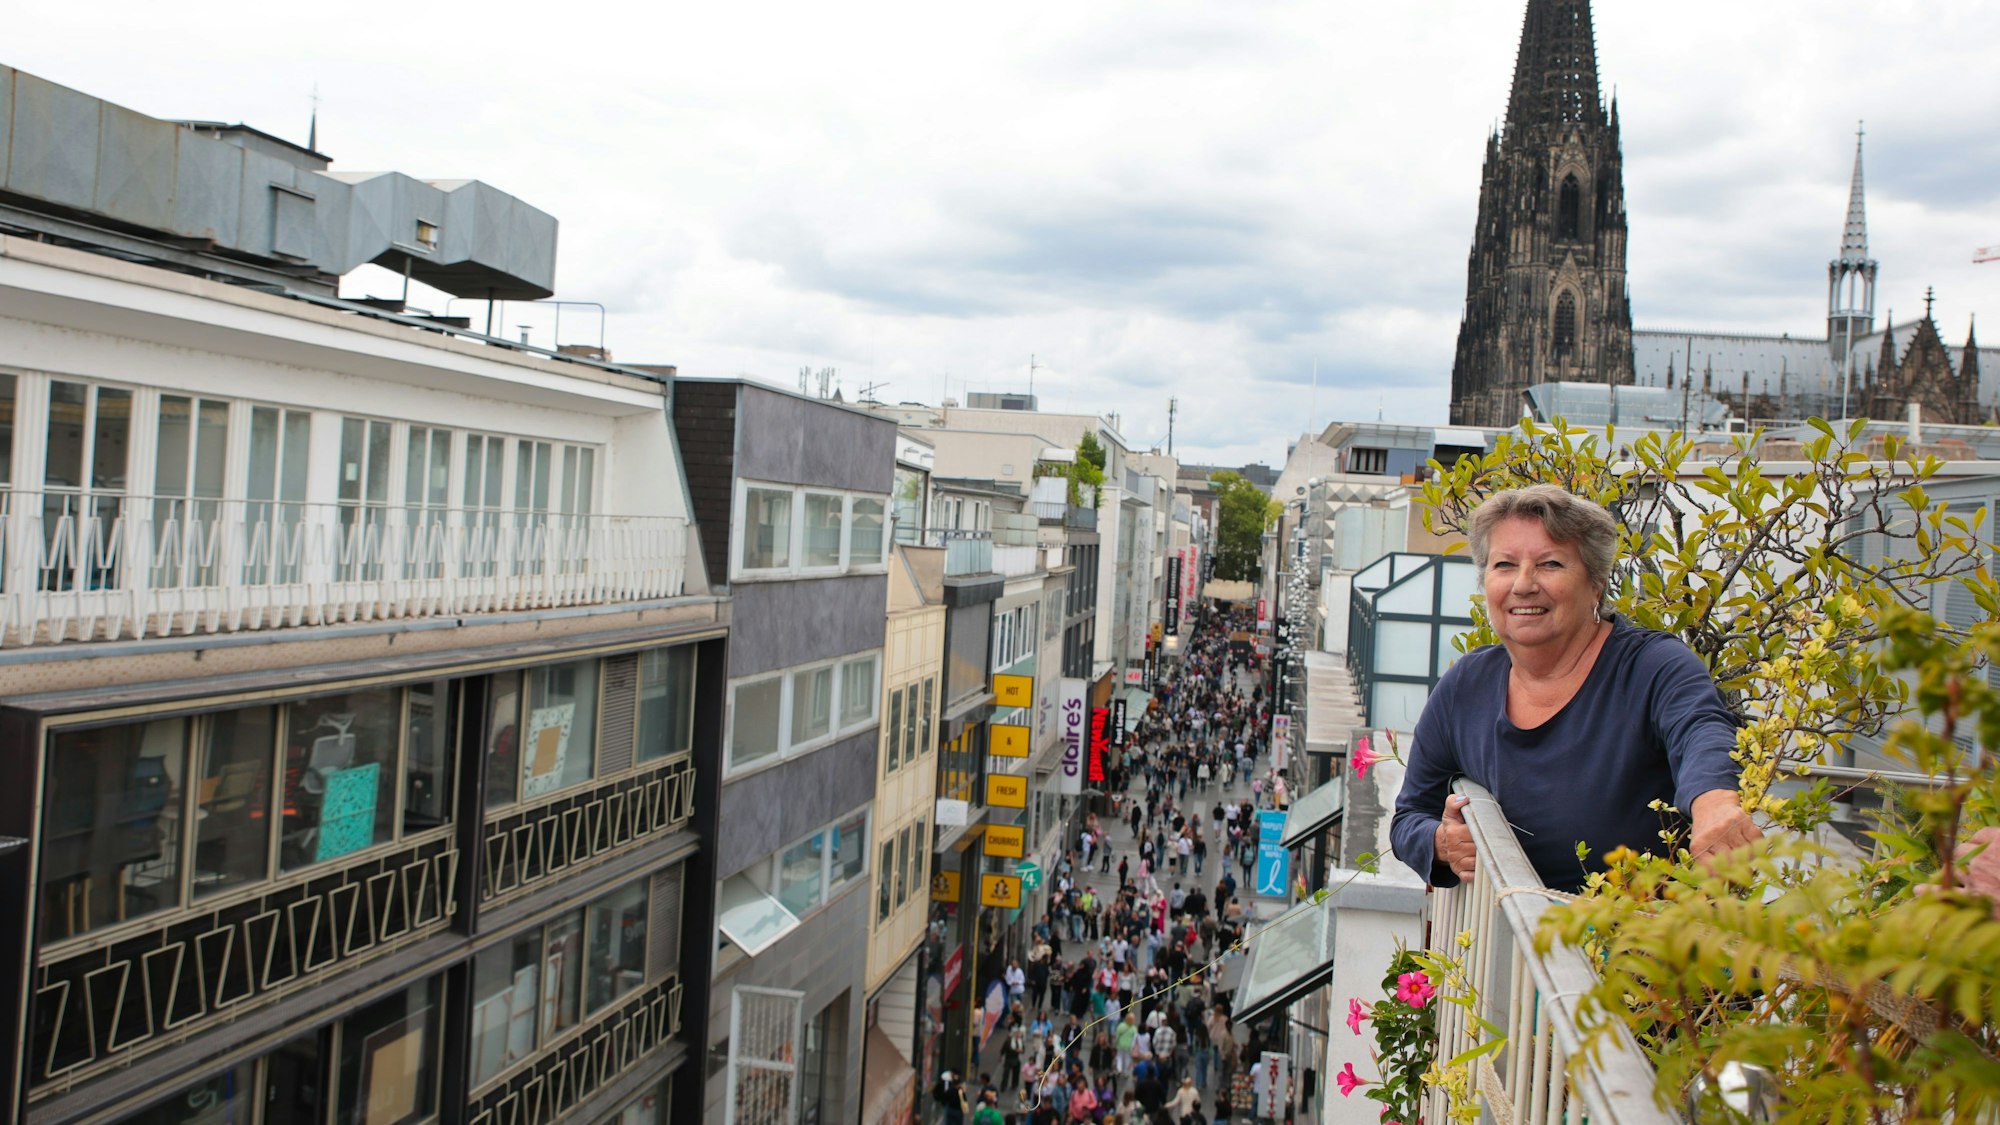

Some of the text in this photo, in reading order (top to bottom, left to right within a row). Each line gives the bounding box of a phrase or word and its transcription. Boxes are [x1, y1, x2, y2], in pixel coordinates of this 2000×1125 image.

[1133, 519, 1149, 647] MINORITENHOF
[1006, 686, 1020, 696] HOT
[1006, 736, 1012, 746] &
[1060, 697, 1082, 777] claire's
[996, 785, 1018, 796] FRESH
[988, 835, 1020, 848] CHURROS
